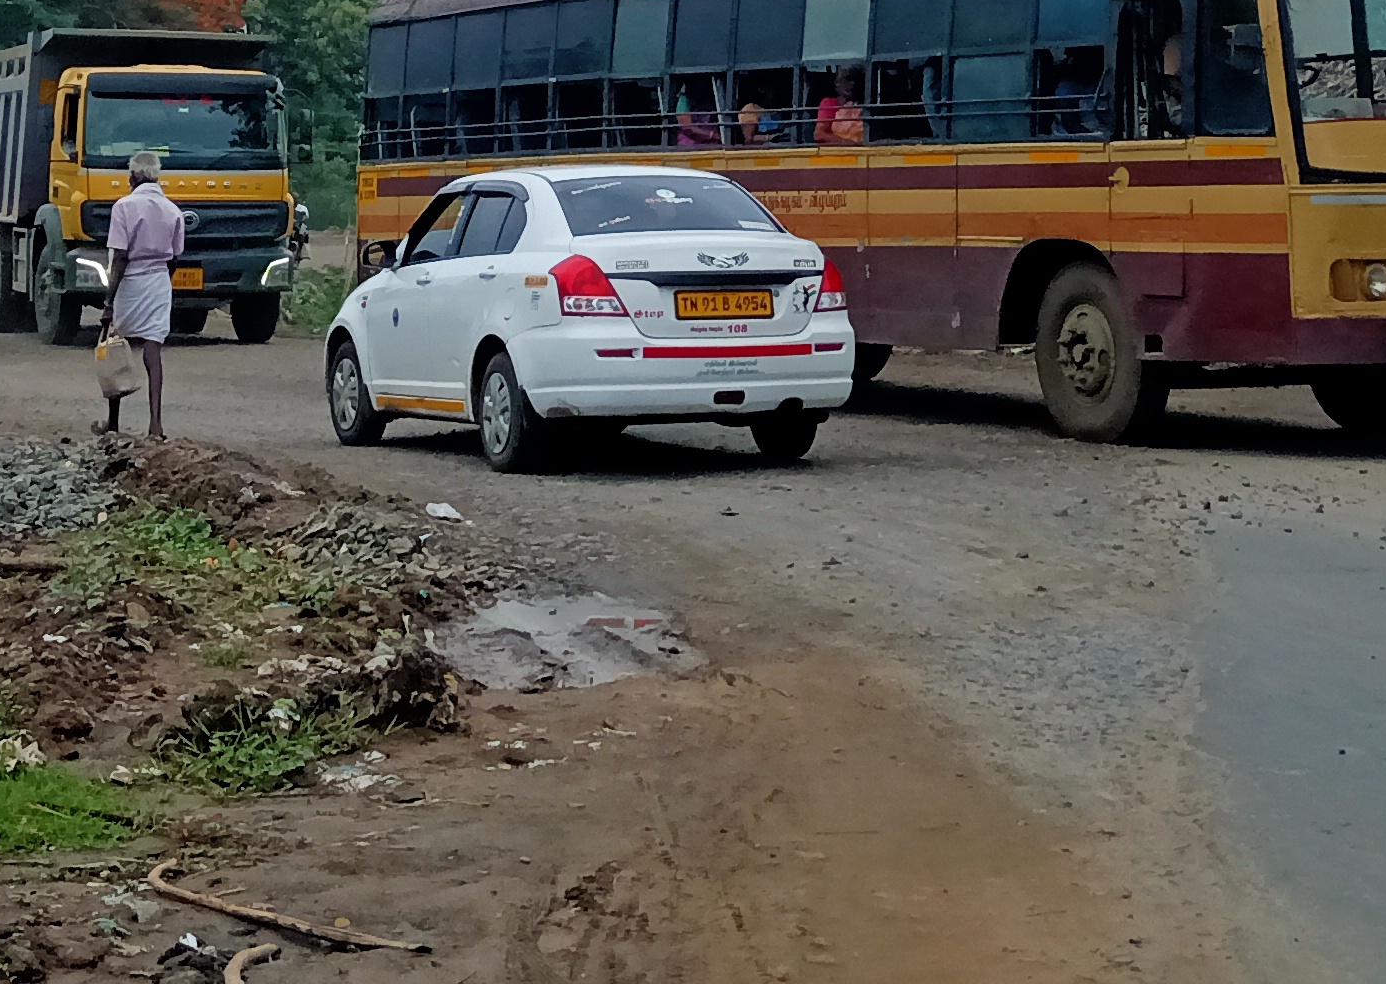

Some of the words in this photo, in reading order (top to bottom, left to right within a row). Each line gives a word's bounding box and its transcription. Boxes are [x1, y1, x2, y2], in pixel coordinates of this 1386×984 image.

[680, 296, 699, 312] TN
[702, 296, 719, 312] 91
[722, 296, 731, 312] B
[734, 295, 768, 312] 4954
[727, 324, 748, 333] 108
